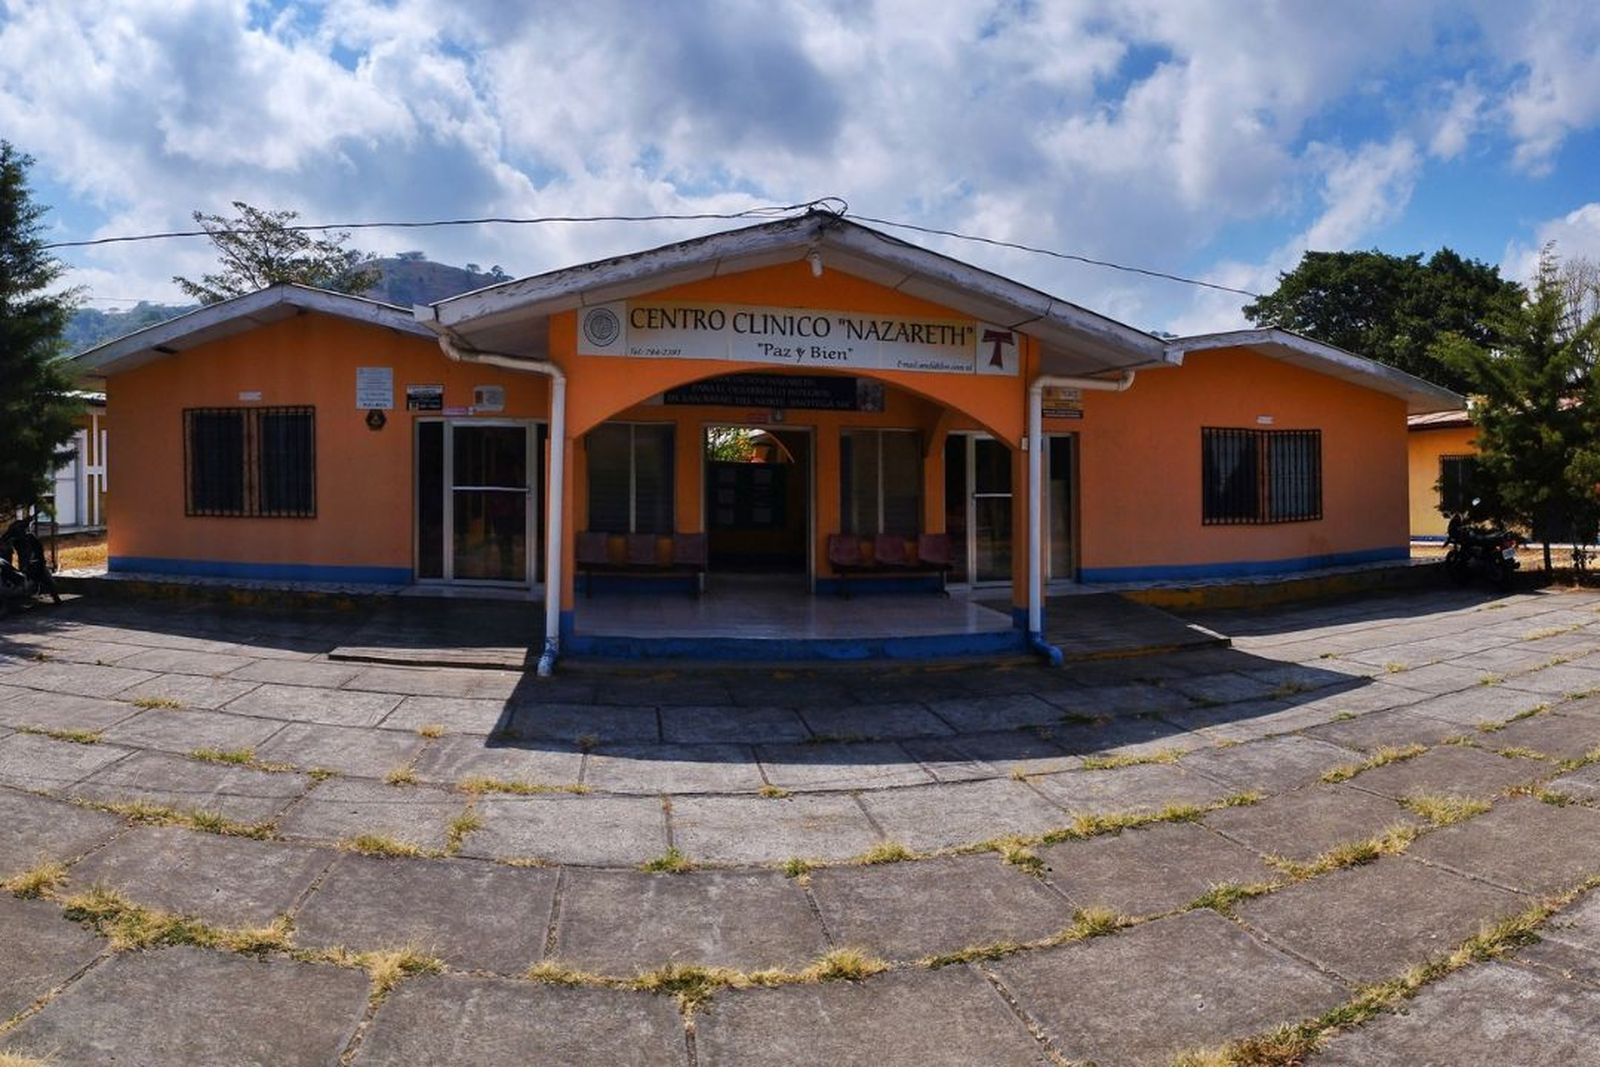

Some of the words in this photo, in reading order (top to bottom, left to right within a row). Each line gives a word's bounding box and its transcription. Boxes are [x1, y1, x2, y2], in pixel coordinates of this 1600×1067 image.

[630, 307, 726, 331] CENTRO
[733, 312, 831, 338] CLINICO
[838, 318, 974, 346] "NAZARETH"
[757, 343, 792, 359] "Paz
[796, 347, 806, 363] y
[810, 346, 854, 361] Bien"
